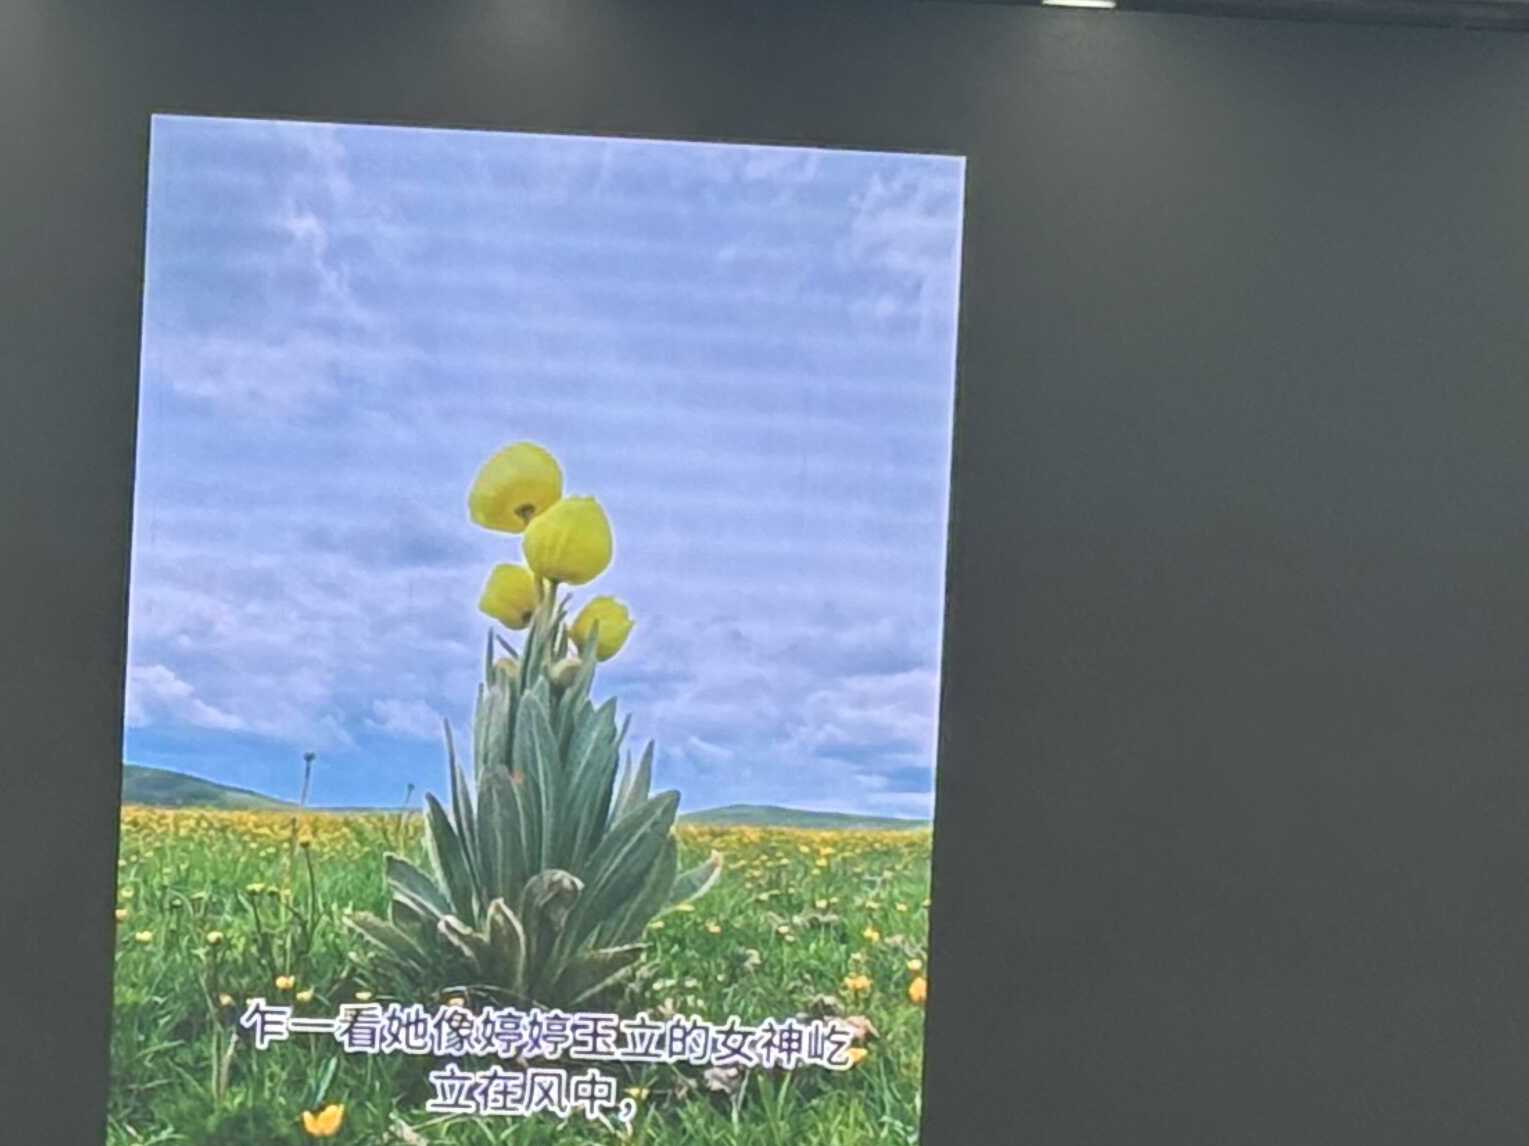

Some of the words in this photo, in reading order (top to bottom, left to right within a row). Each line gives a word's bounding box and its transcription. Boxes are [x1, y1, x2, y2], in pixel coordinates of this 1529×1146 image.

[241, 1001, 853, 1069] 乍一看她像婷婷玉立的女神屹
